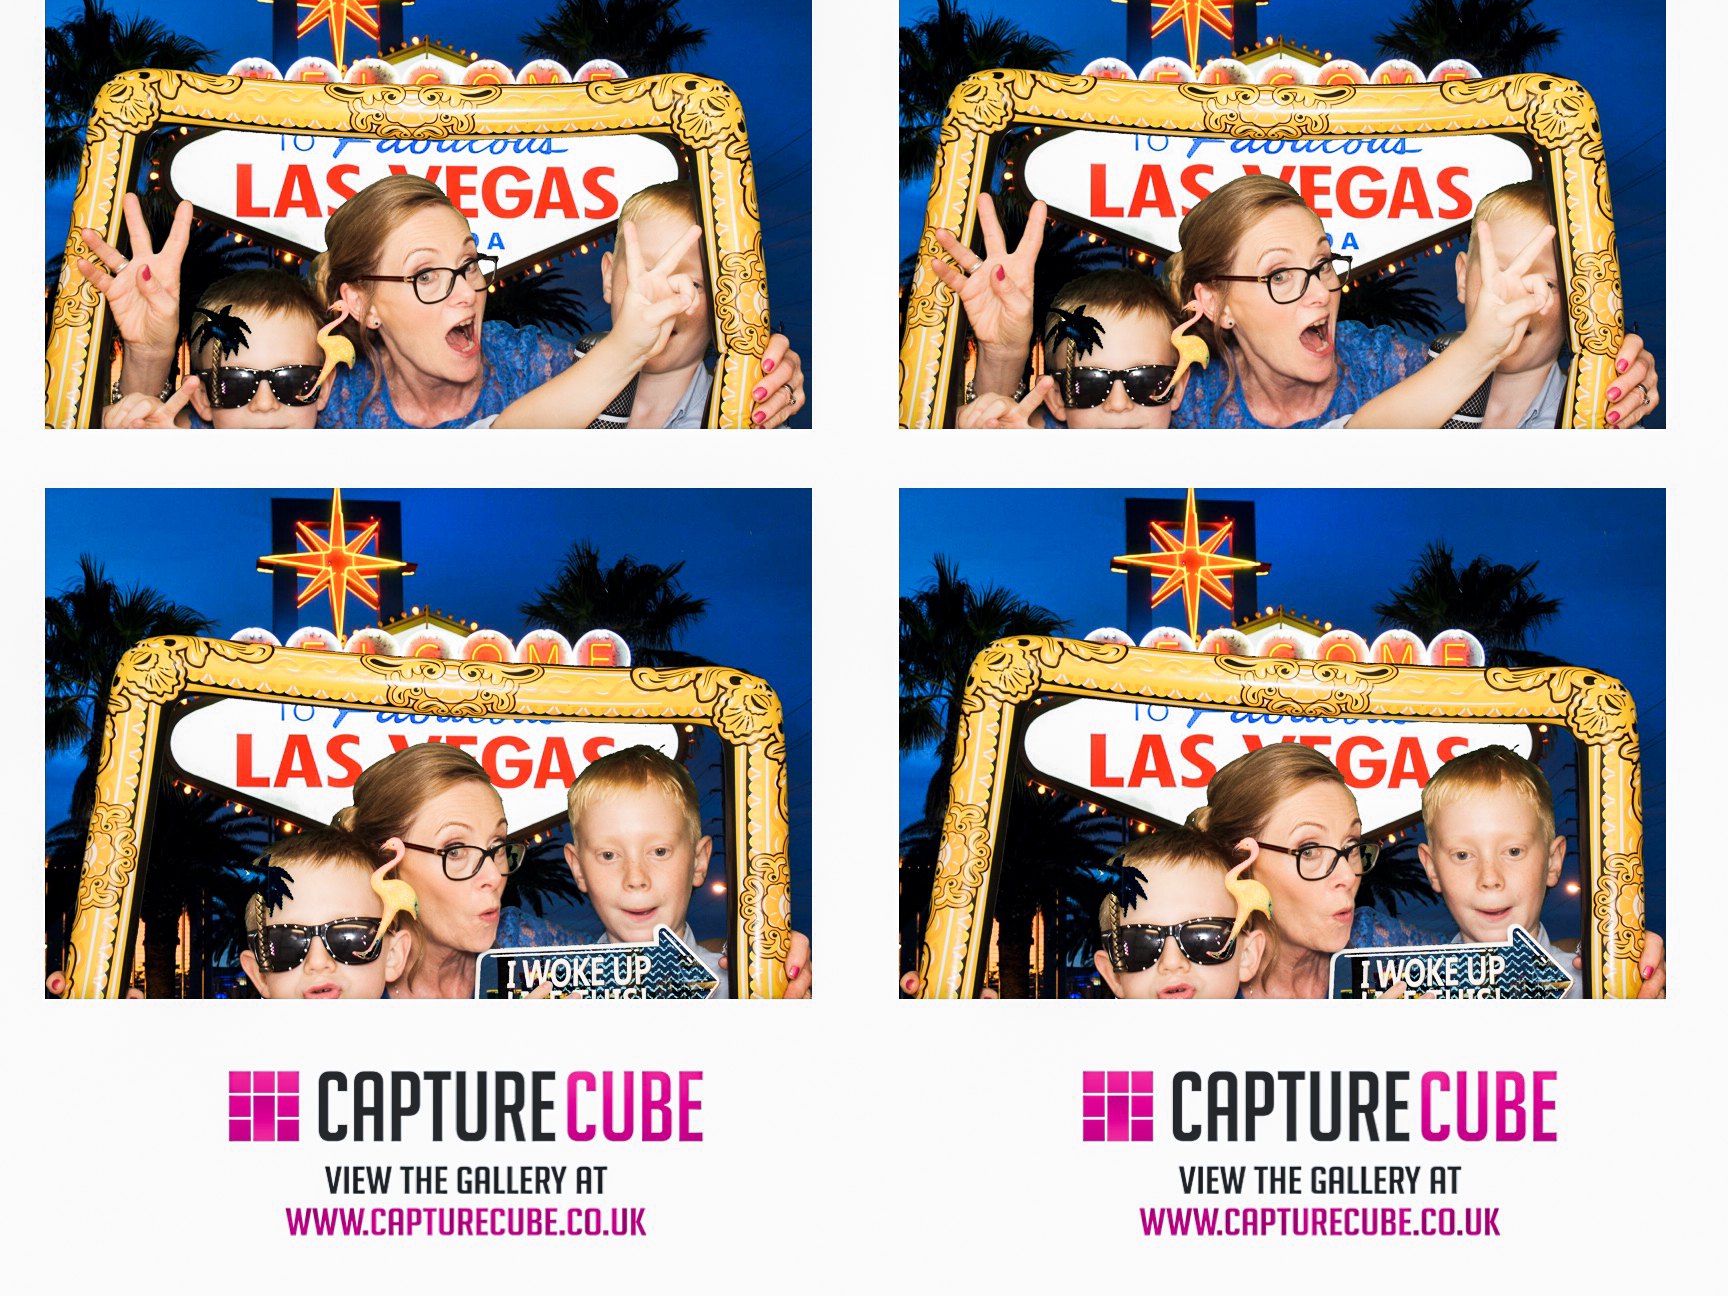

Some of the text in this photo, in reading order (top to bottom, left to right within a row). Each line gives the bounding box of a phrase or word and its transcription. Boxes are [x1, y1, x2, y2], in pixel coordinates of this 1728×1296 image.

[236, 734, 363, 789] LAS
[1090, 734, 1217, 789] LAS
[523, 956, 604, 989] WOKE
[613, 955, 651, 986] UP
[1377, 956, 1458, 989] WOKE
[1467, 955, 1505, 986] UP
